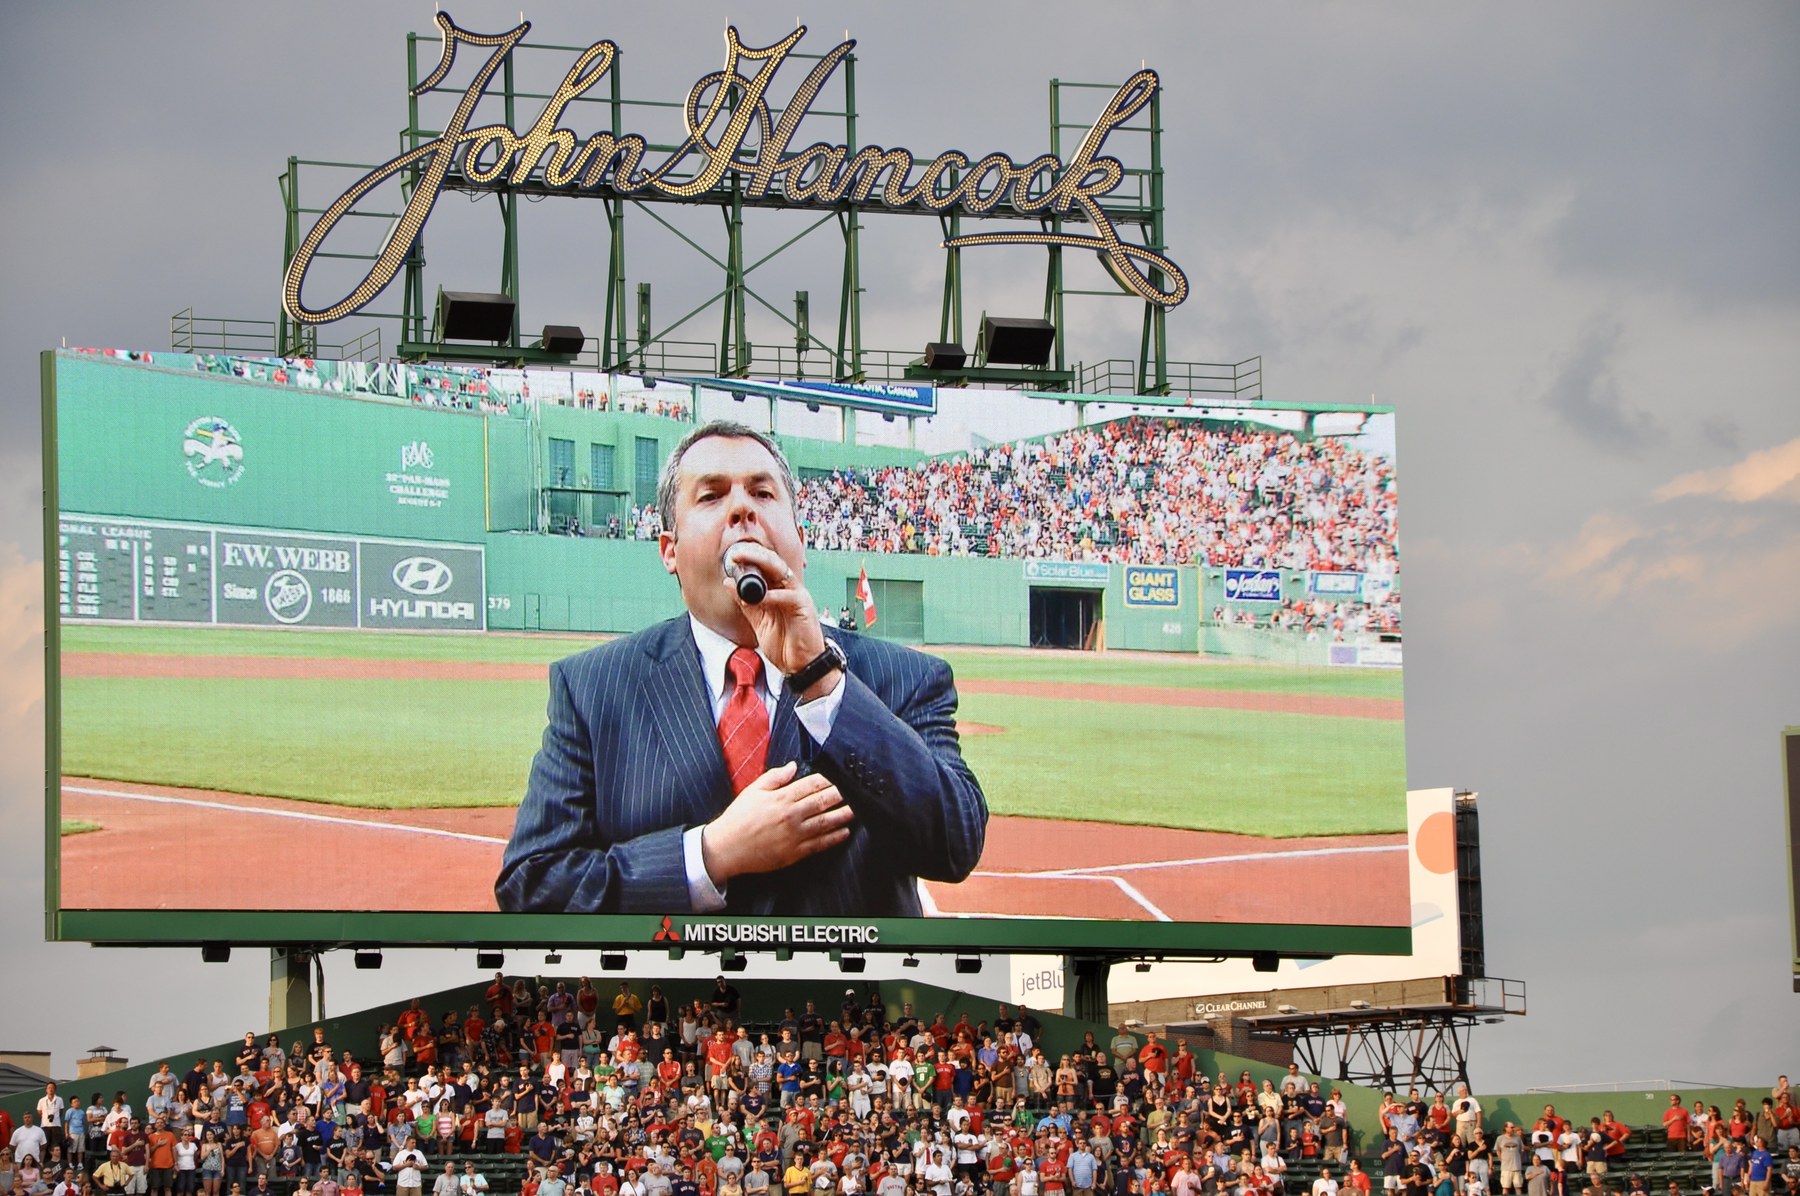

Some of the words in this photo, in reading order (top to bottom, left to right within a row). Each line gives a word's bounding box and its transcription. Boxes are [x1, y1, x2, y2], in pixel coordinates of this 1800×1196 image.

[283, 11, 650, 324] John
[640, 25, 1189, 306] Hancock
[275, 546, 351, 572] WEBB
[1129, 571, 1175, 588] GIANT
[488, 595, 511, 610] 379
[1128, 586, 1176, 602] GLASS
[369, 597, 475, 620] HYUNDAI
[684, 923, 787, 942] MITSUBISHI
[791, 925, 879, 943] ELECTRIC
